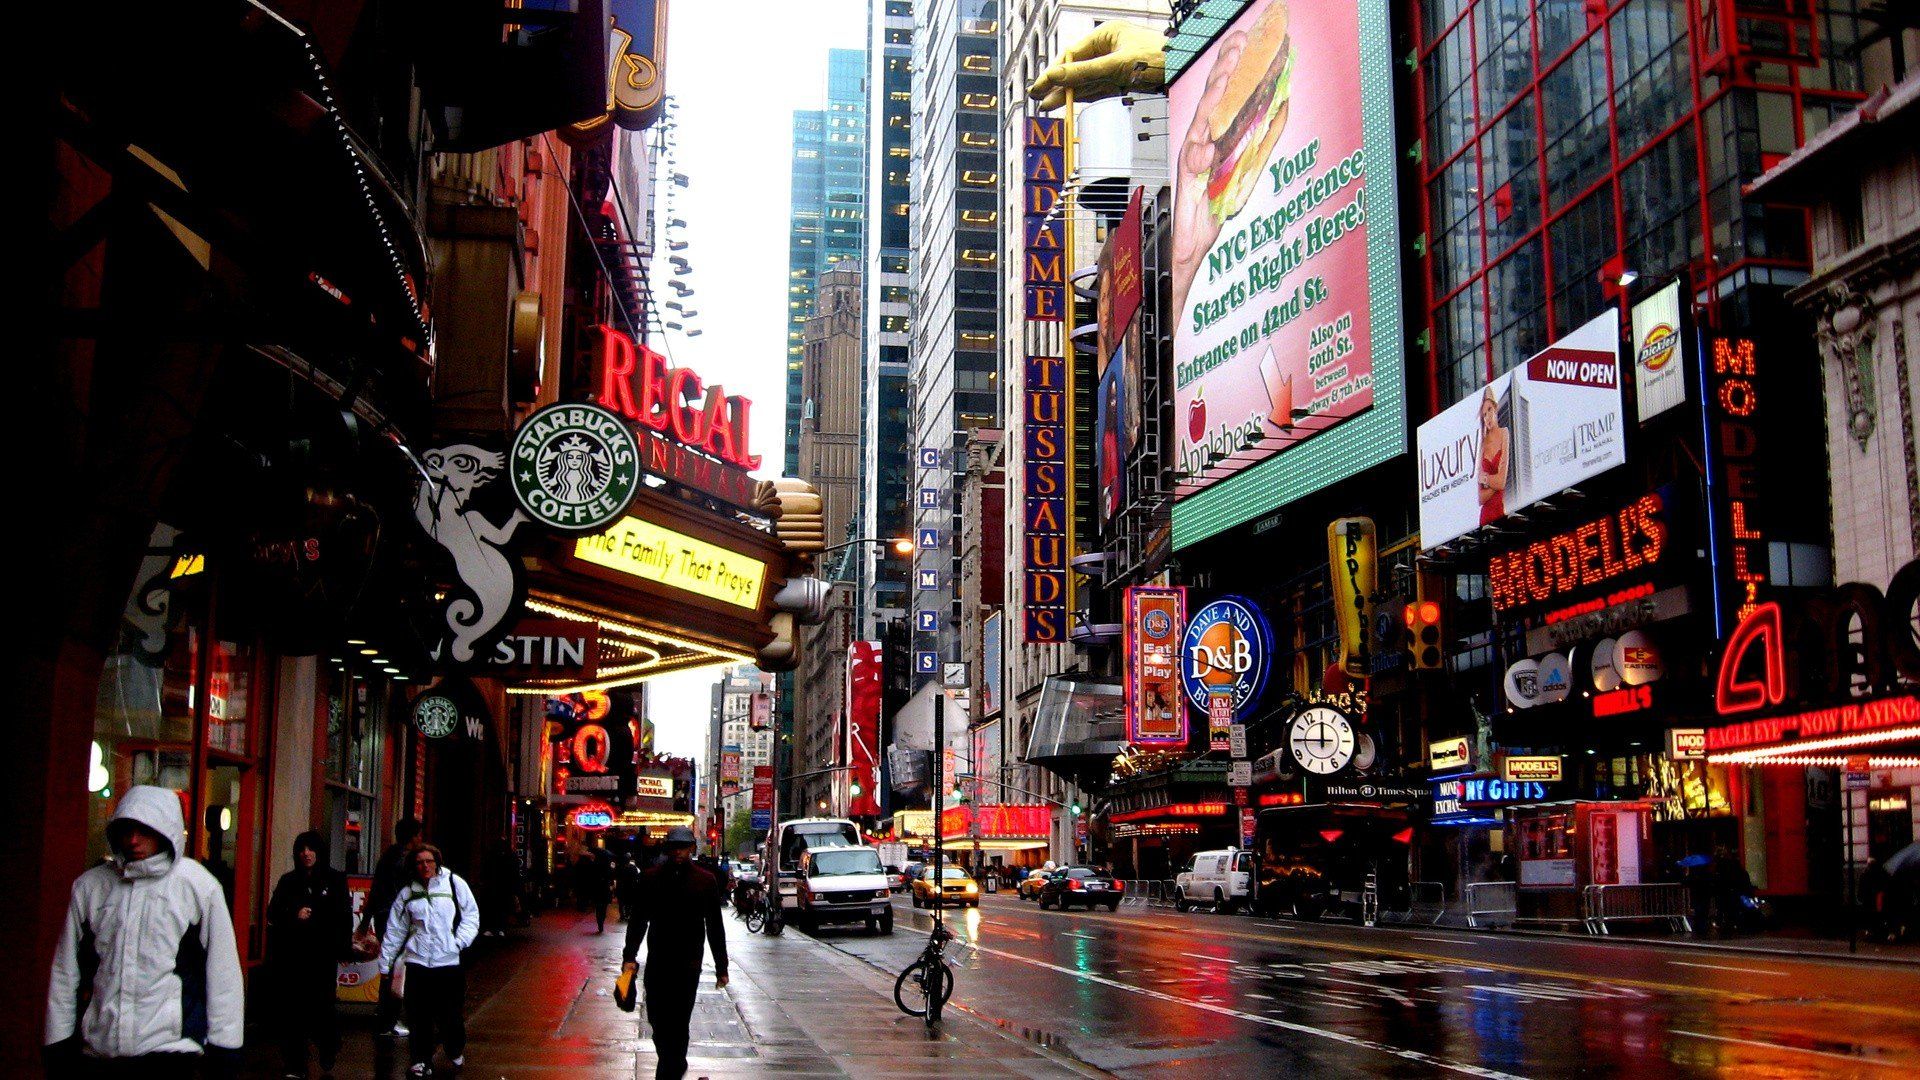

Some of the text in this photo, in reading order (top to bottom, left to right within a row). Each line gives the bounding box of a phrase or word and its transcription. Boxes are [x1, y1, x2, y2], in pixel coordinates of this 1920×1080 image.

[1270, 138, 1320, 195] Your
[1027, 118, 1061, 319] MADAME
[1208, 234, 1247, 284] NYC
[1250, 150, 1365, 244] Experience
[1193, 189, 1367, 334] Starts Right Here!
[1176, 276, 1328, 389] Entrance on 42nd St.
[1309, 314, 1351, 350] Also on
[1309, 338, 1354, 376] 50th St.
[1547, 360, 1614, 384] NOW OPEN
[1315, 366, 1347, 389] between
[600, 323, 762, 471] REGAL
[518, 410, 633, 466] STARBUCKS
[1178, 413, 1263, 484] Applebee's
[637, 430, 748, 498] INEMAS
[1420, 429, 1480, 492] luxury
[526, 489, 618, 523] COFFEE
[1030, 357, 1061, 640] TUSSAUD'S
[621, 531, 674, 580] Family
[680, 549, 712, 582] That
[921, 450, 938, 670] CHAMPS
[1490, 495, 1663, 611] MODELL'S
[1190, 606, 1250, 640] DAVE AND
[1143, 643, 1172, 654] Eat
[1189, 639, 1252, 679] D&B
[1624, 663, 1658, 671] EASTON
[1143, 667, 1172, 680] Play
[1542, 684, 1567, 692] adidas
[421, 724, 451, 737] COFFEE
[1303, 712, 1316, 726] 12
[1341, 722, 1350, 733] 3
[1709, 696, 1915, 749] EAGLE EYE NOW PLAYING
[1293, 749, 1303, 760] 9
[1330, 758, 1339, 769] 6
[1510, 761, 1558, 772] MODELL'S
[1327, 786, 1358, 797] Hilton
[1377, 786, 1406, 797] Times
